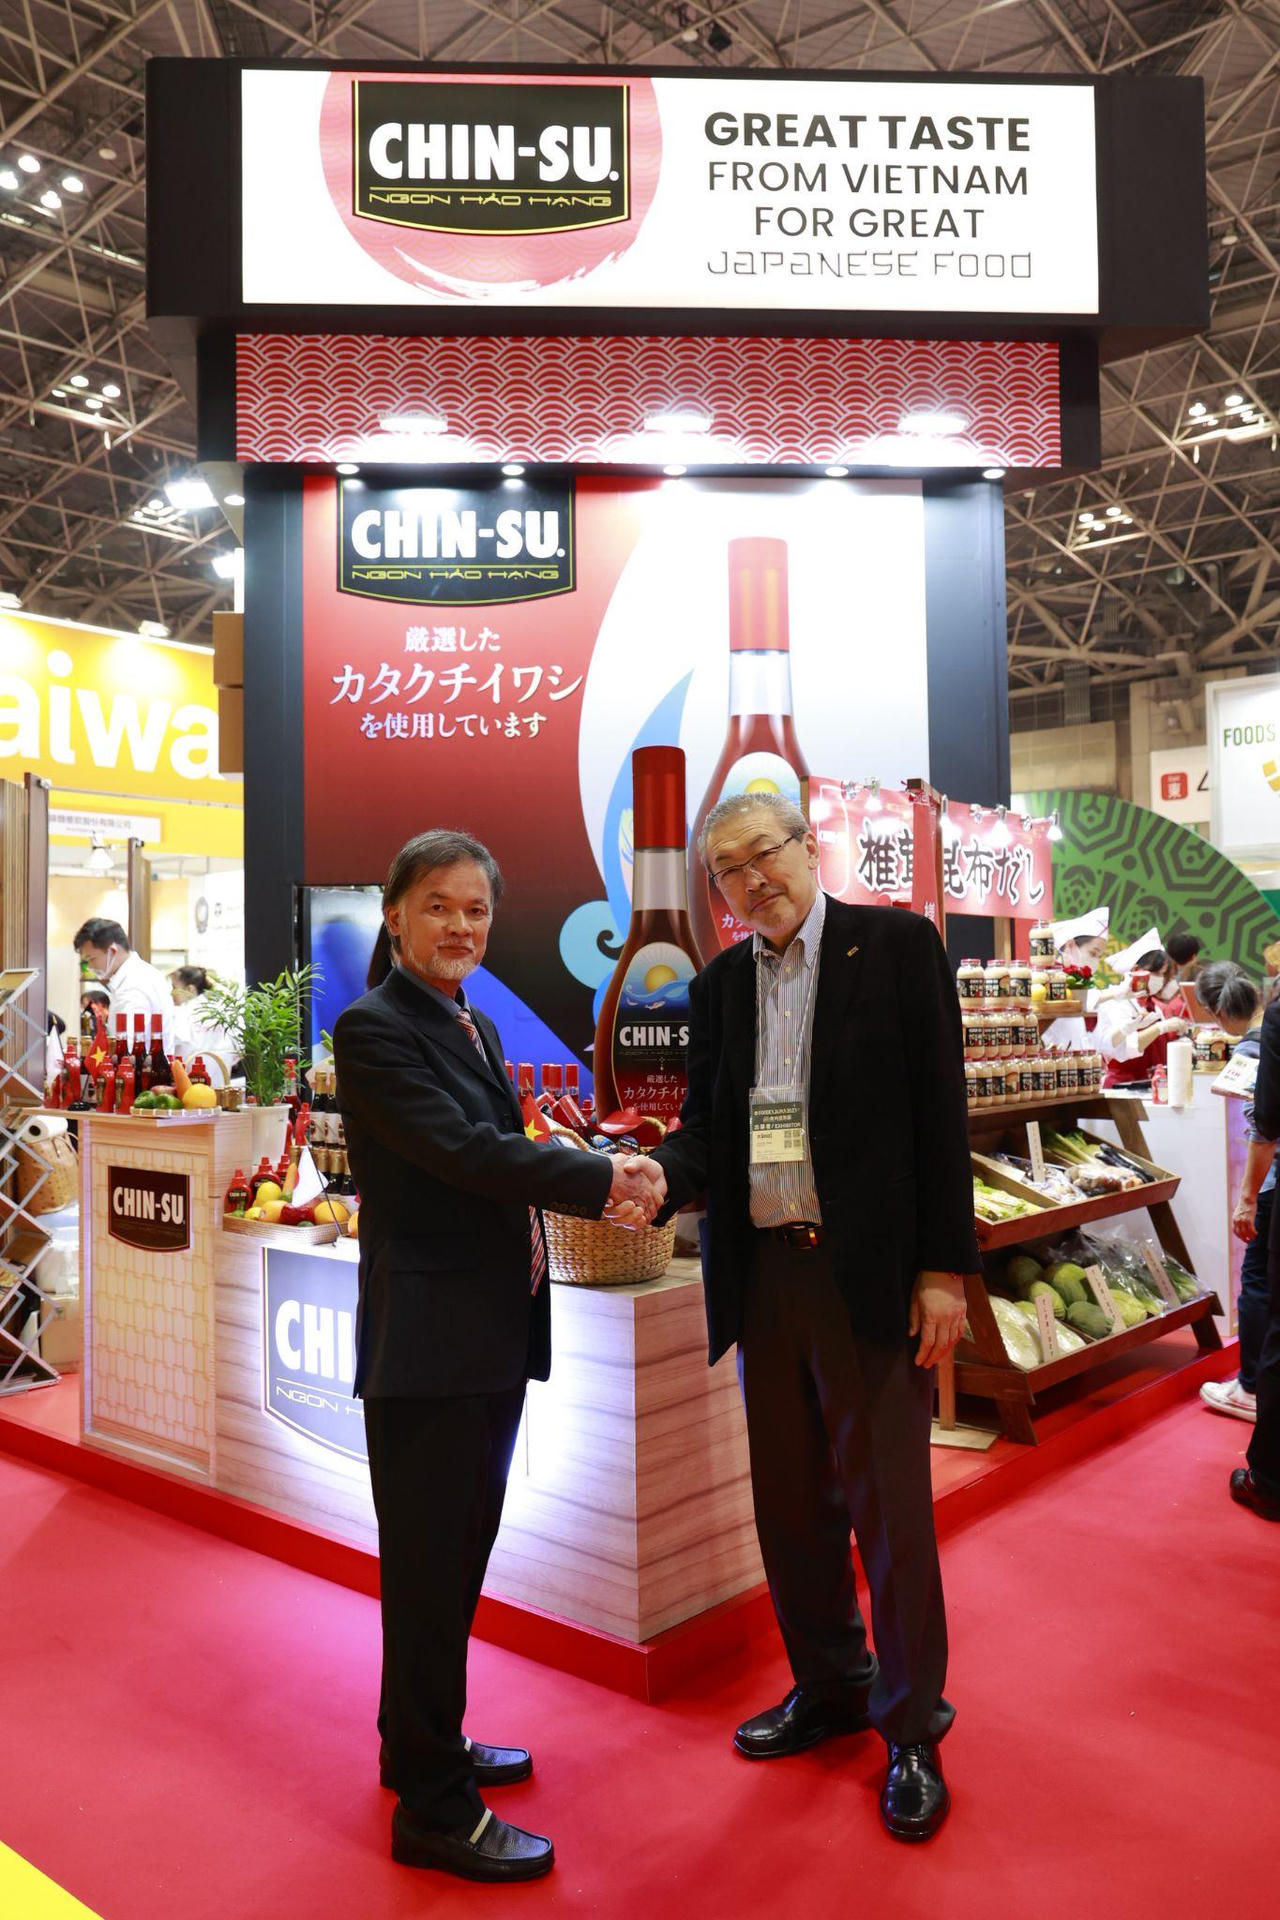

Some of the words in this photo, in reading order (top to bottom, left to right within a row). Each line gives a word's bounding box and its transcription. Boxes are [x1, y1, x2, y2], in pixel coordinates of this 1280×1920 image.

[705, 112, 867, 148] GREAT
[879, 115, 1030, 151] TASTE
[709, 161, 826, 192] FROM
[842, 164, 1027, 195] VIETNAM
[369, 193, 450, 205] NGON
[756, 207, 834, 237] FOR
[849, 208, 984, 238] GREAT
[352, 571, 422, 580] NGON
[404, 626, 501, 652] 厳選した
[330, 662, 583, 705] カタクチイワシ
[360, 712, 546, 738] を使用しています
[1223, 724, 1276, 748] FOODS
[276, 1385, 338, 1412] NGON
